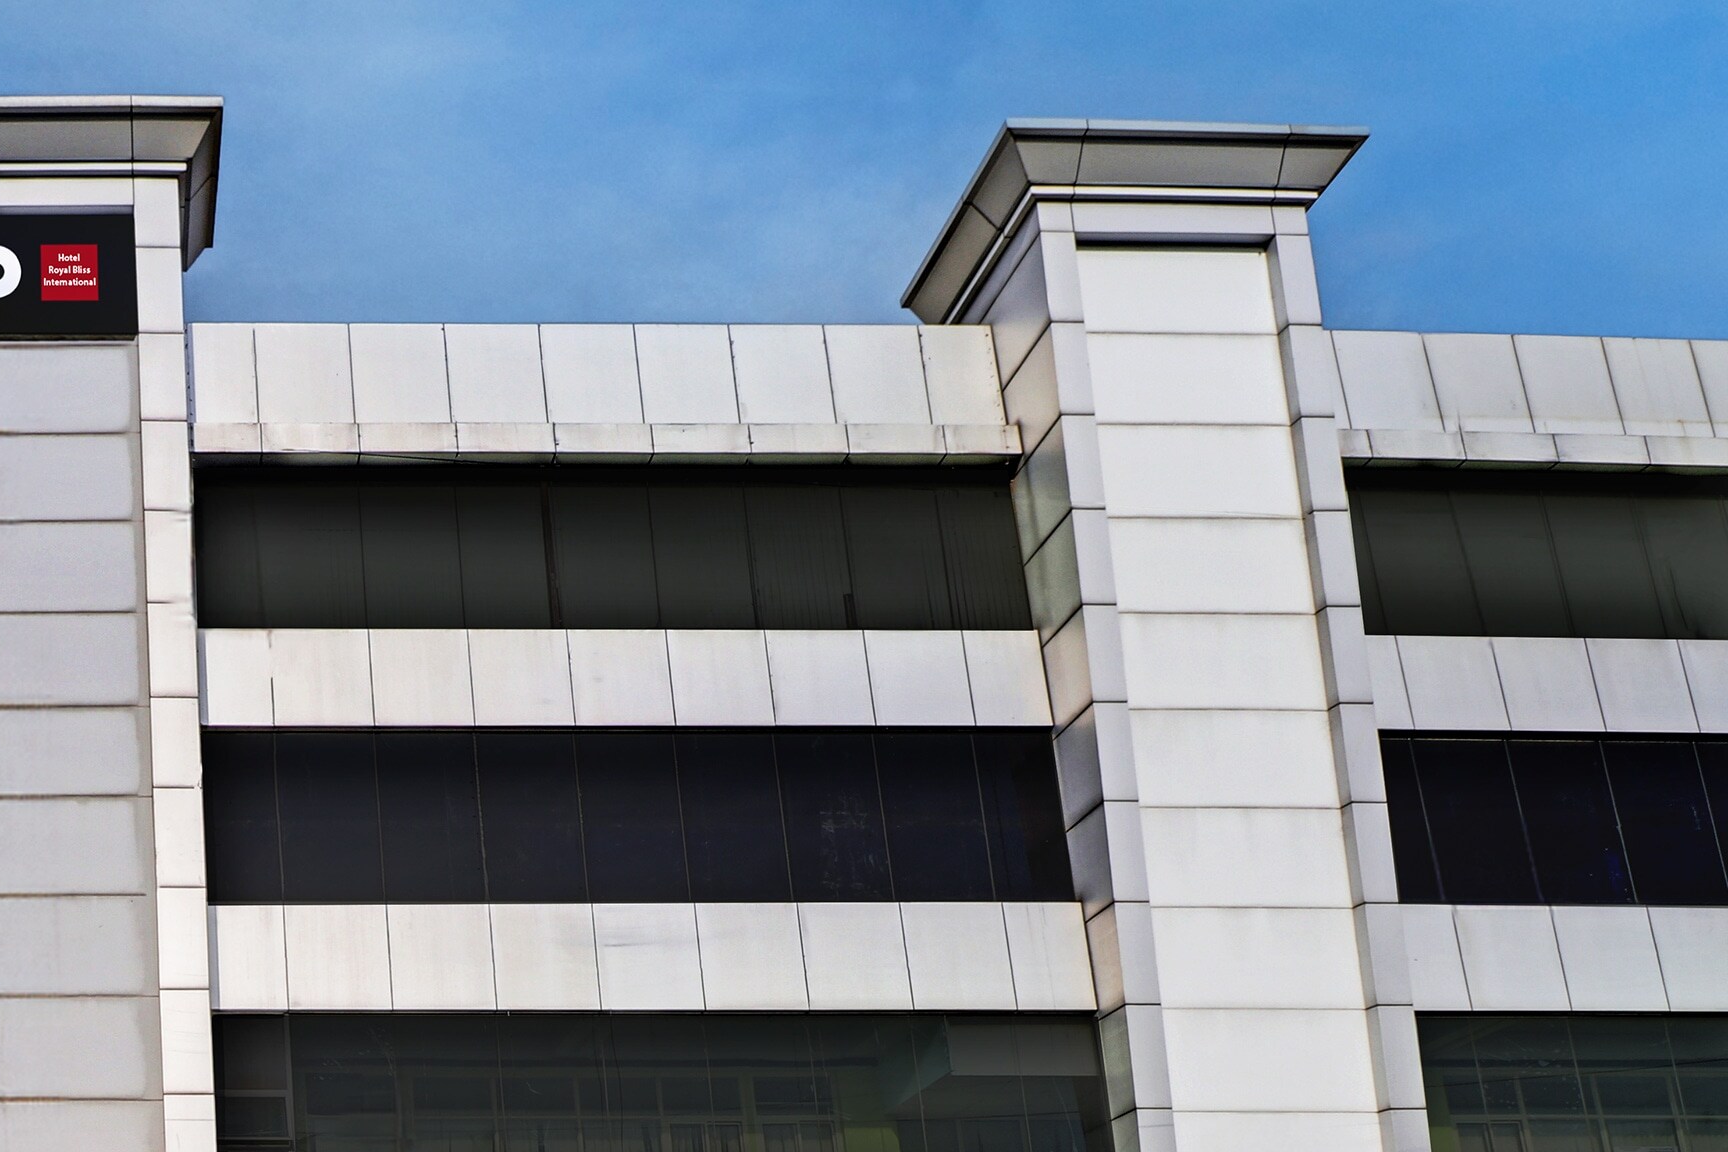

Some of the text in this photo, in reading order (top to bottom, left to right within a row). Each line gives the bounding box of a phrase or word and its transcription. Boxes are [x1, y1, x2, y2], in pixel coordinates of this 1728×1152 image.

[58, 253, 81, 262] Hotel
[48, 265, 91, 276] Royal Bliss
[43, 277, 97, 286] International
